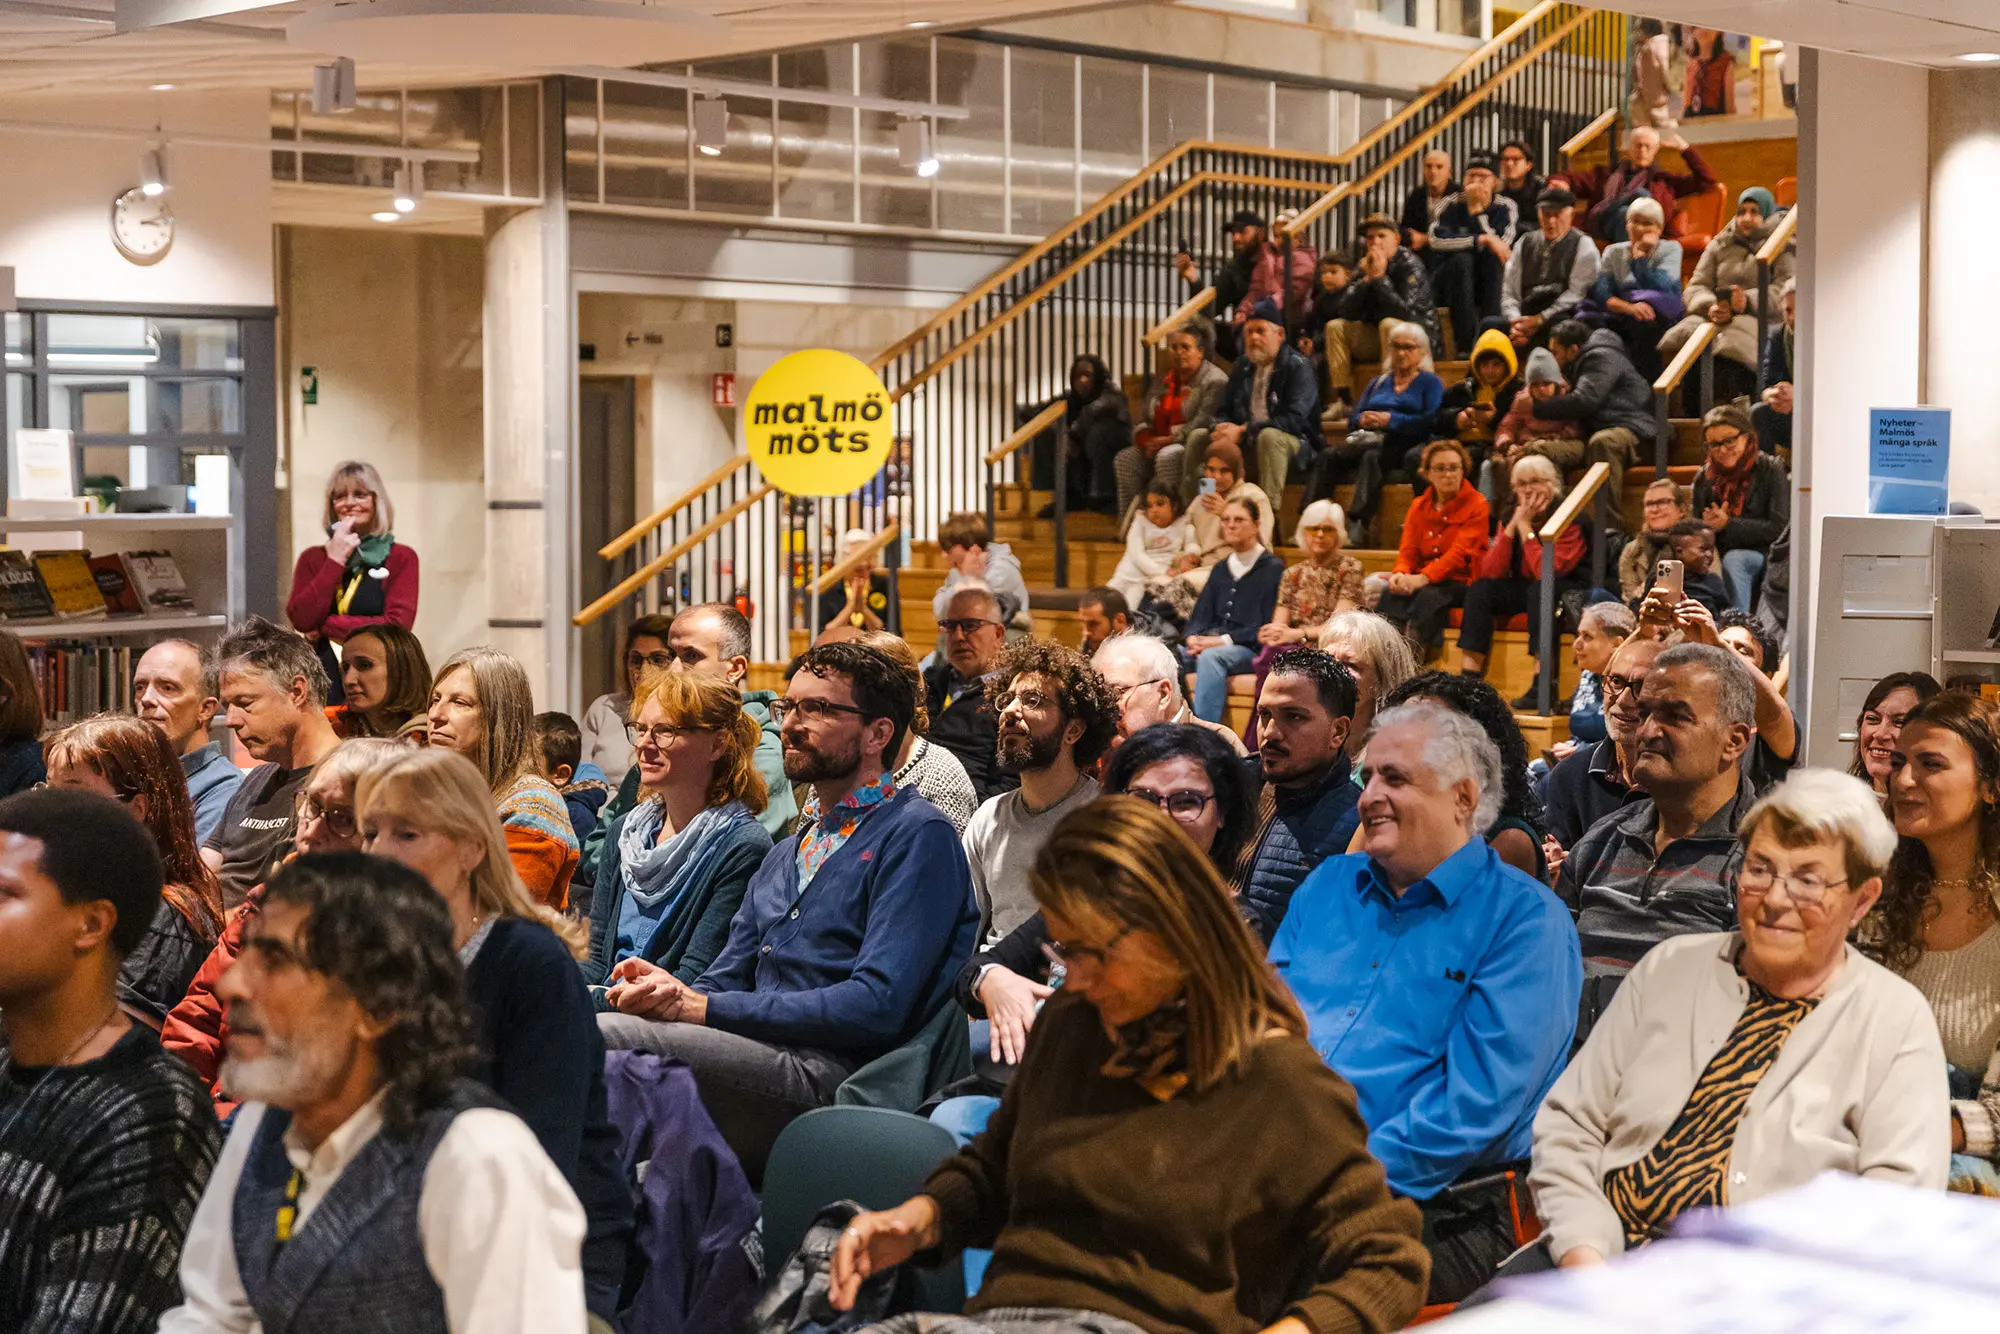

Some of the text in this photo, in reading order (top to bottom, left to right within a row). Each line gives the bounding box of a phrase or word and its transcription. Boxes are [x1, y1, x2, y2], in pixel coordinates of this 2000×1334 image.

[754, 392, 883, 424] malmö
[1879, 418, 1917, 428] Nyheter
[1879, 428, 1915, 437] Malmös
[769, 425, 870, 455] möts
[1879, 438, 1938, 448] många språk
